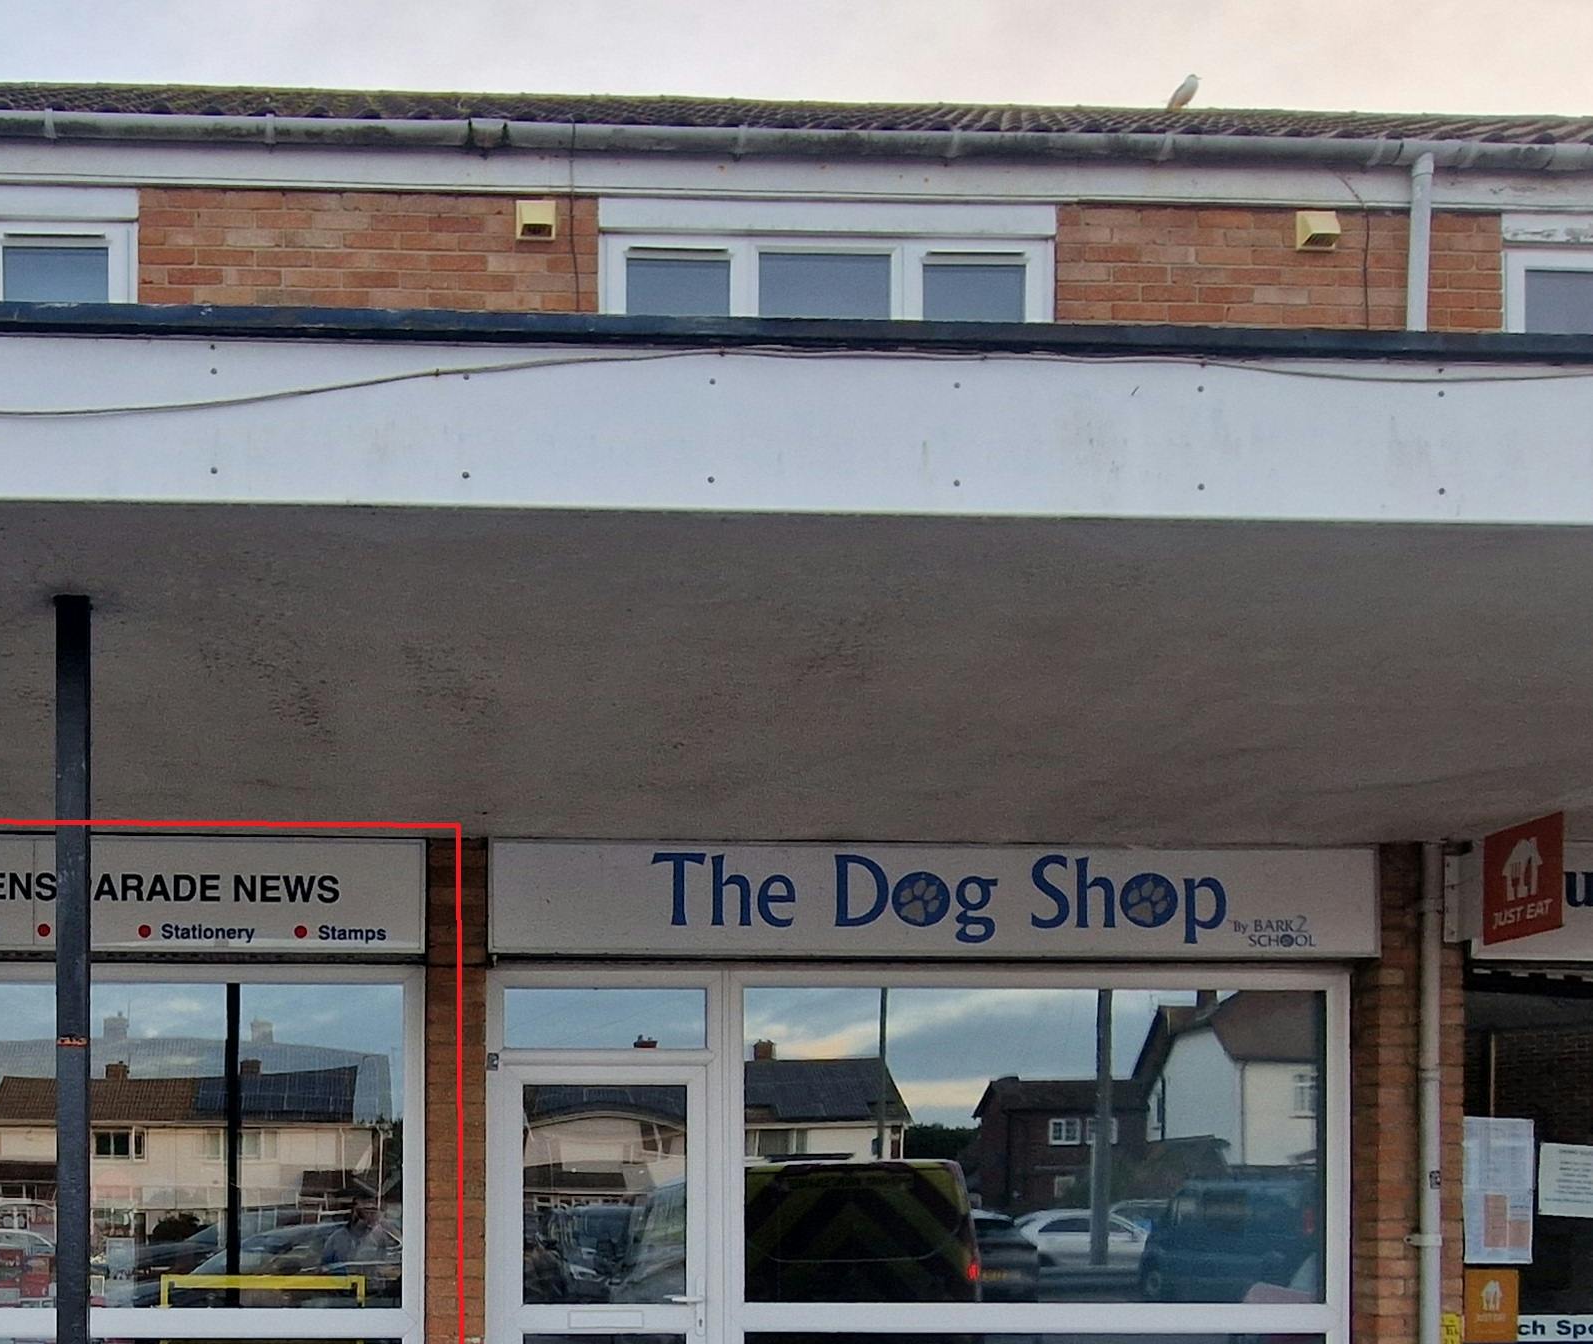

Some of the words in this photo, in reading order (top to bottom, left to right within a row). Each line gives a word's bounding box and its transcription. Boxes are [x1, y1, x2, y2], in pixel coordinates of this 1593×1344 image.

[91, 873, 220, 902] ARADE
[233, 875, 340, 903] NEWS
[651, 852, 796, 928] The
[834, 854, 998, 943] Dog
[1031, 854, 1228, 944] Shop
[1492, 906, 1524, 930] JUST
[1526, 898, 1553, 919] EAT
[161, 924, 255, 943] Stationery
[318, 925, 387, 944] Stamps
[1233, 920, 1248, 934] By
